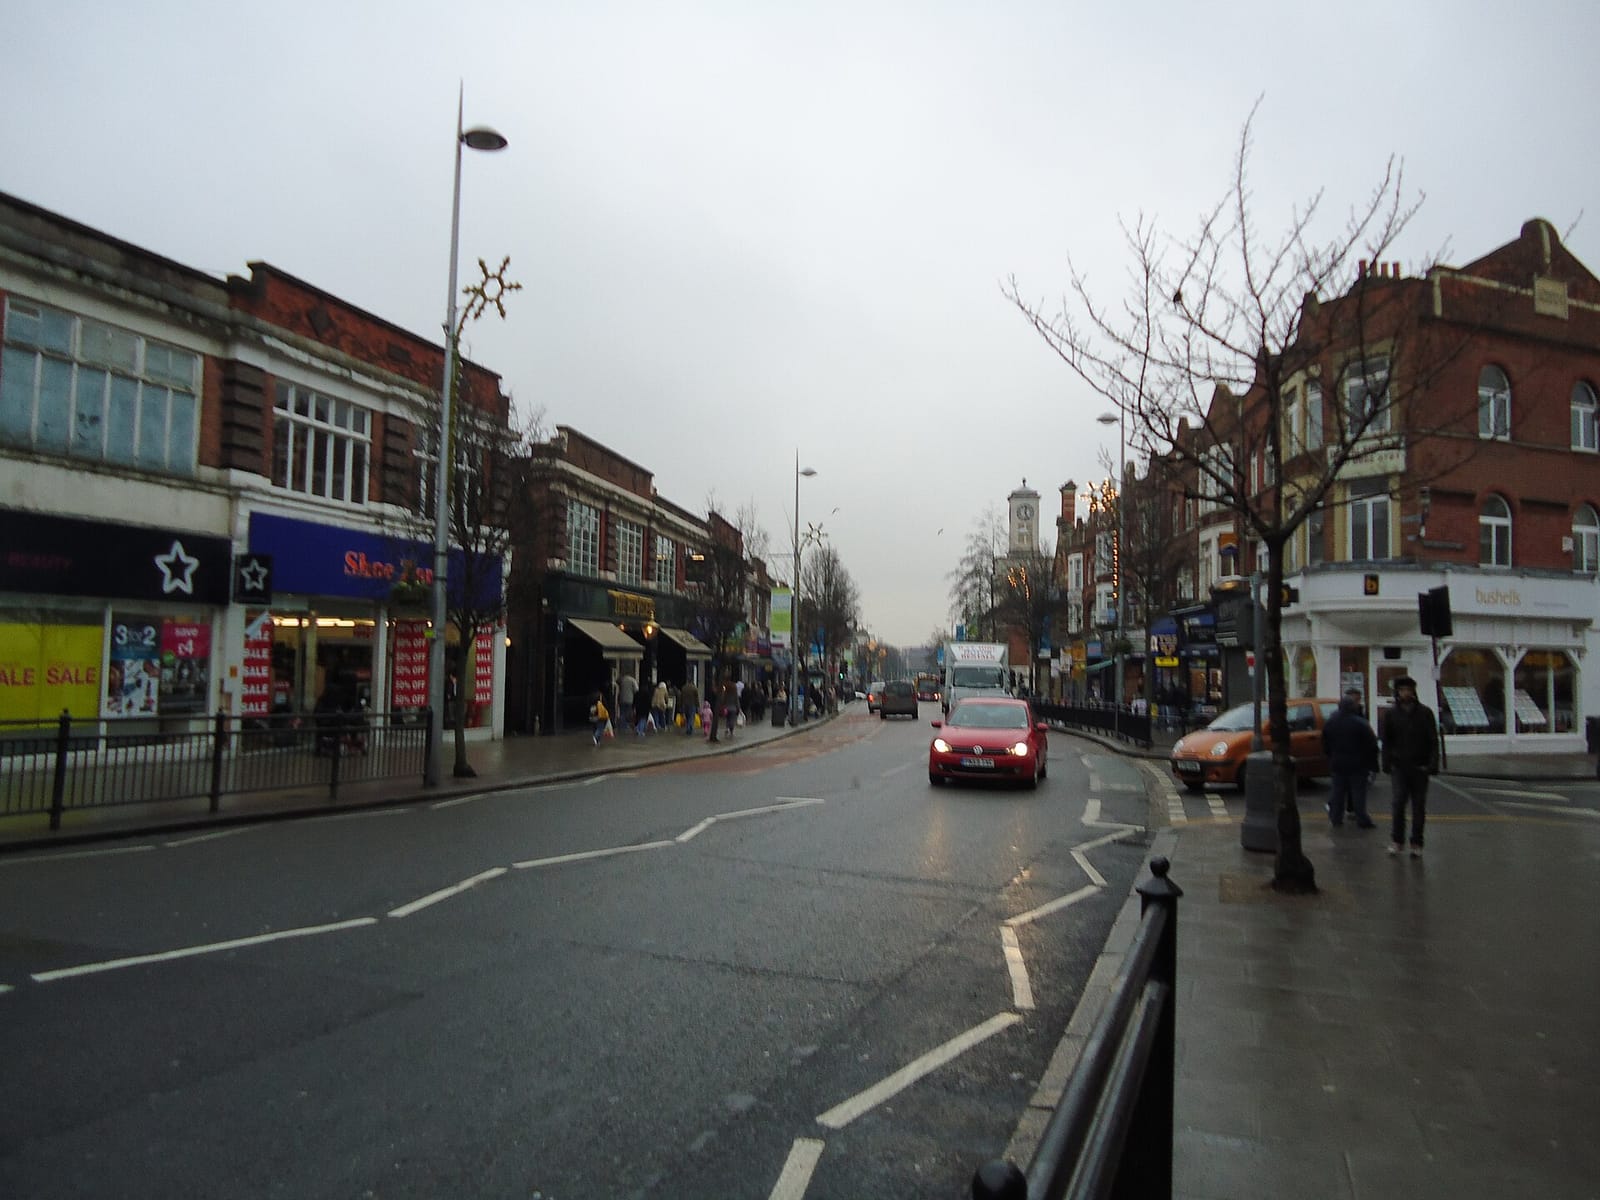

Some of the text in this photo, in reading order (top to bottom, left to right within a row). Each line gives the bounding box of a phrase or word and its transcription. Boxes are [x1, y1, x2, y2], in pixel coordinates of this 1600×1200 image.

[344, 550, 395, 581] Shoe
[1475, 586, 1521, 605] bushells
[115, 624, 128, 645] 3
[143, 625, 156, 646] 2
[413, 638, 425, 647] OFF
[476, 638, 491, 648] SALE
[413, 652, 425, 661] OFF
[244, 666, 269, 677] SALE
[412, 665, 425, 675] OFF
[47, 667, 97, 685] SALE
[242, 684, 268, 695] SALE
[395, 680, 425, 689] 50% OFF
[394, 694, 424, 704] 50% OFF
[241, 702, 268, 713] SALE
